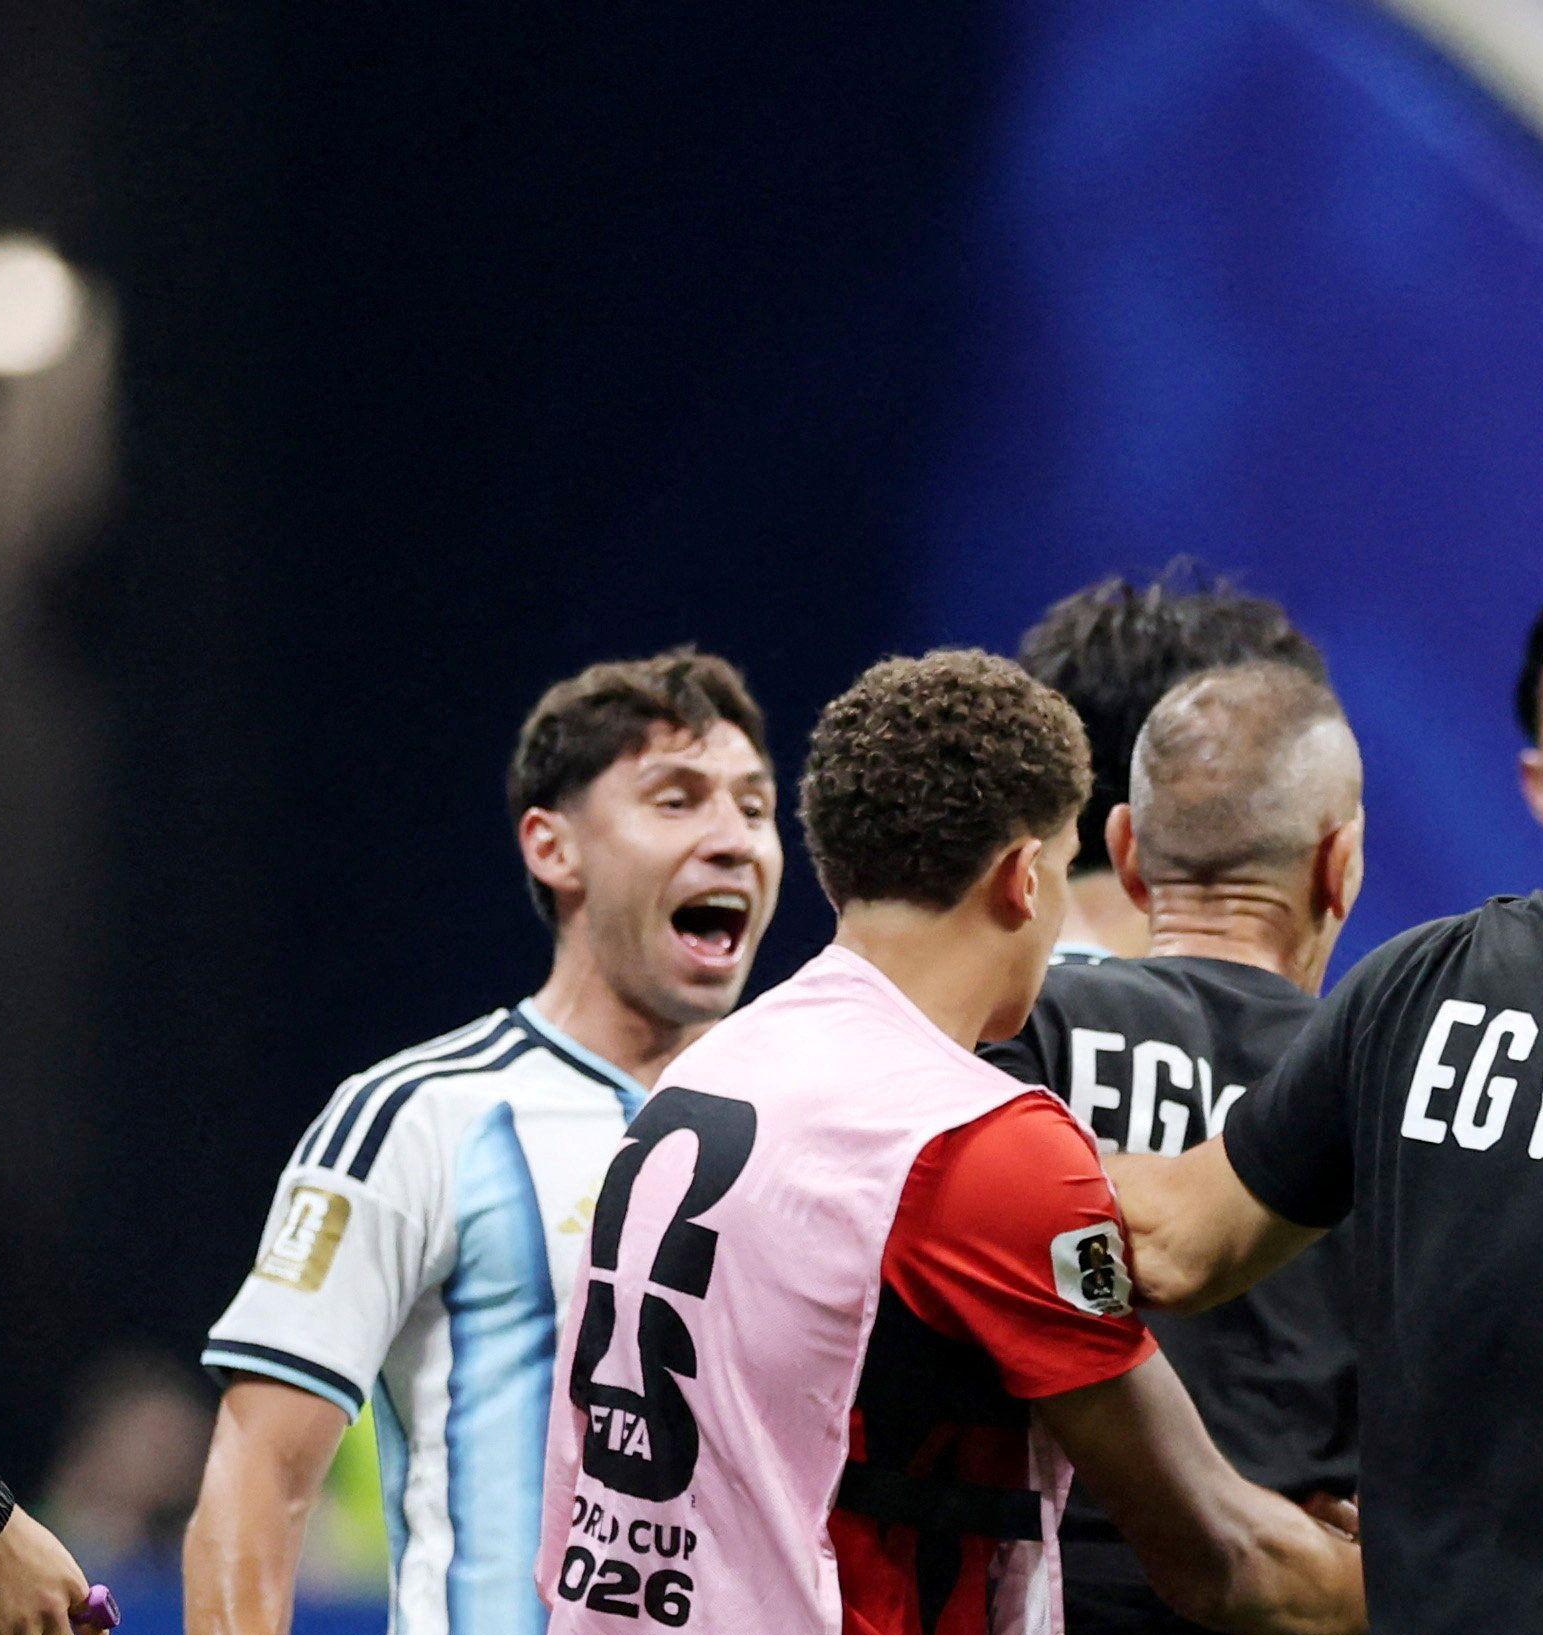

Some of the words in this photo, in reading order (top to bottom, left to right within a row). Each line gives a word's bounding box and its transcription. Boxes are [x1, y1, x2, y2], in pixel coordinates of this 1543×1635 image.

[1070, 1028, 1246, 1158] EGY
[589, 1404, 652, 1462] FIFA
[628, 1519, 697, 1561] CUP
[558, 1545, 695, 1628] 026
